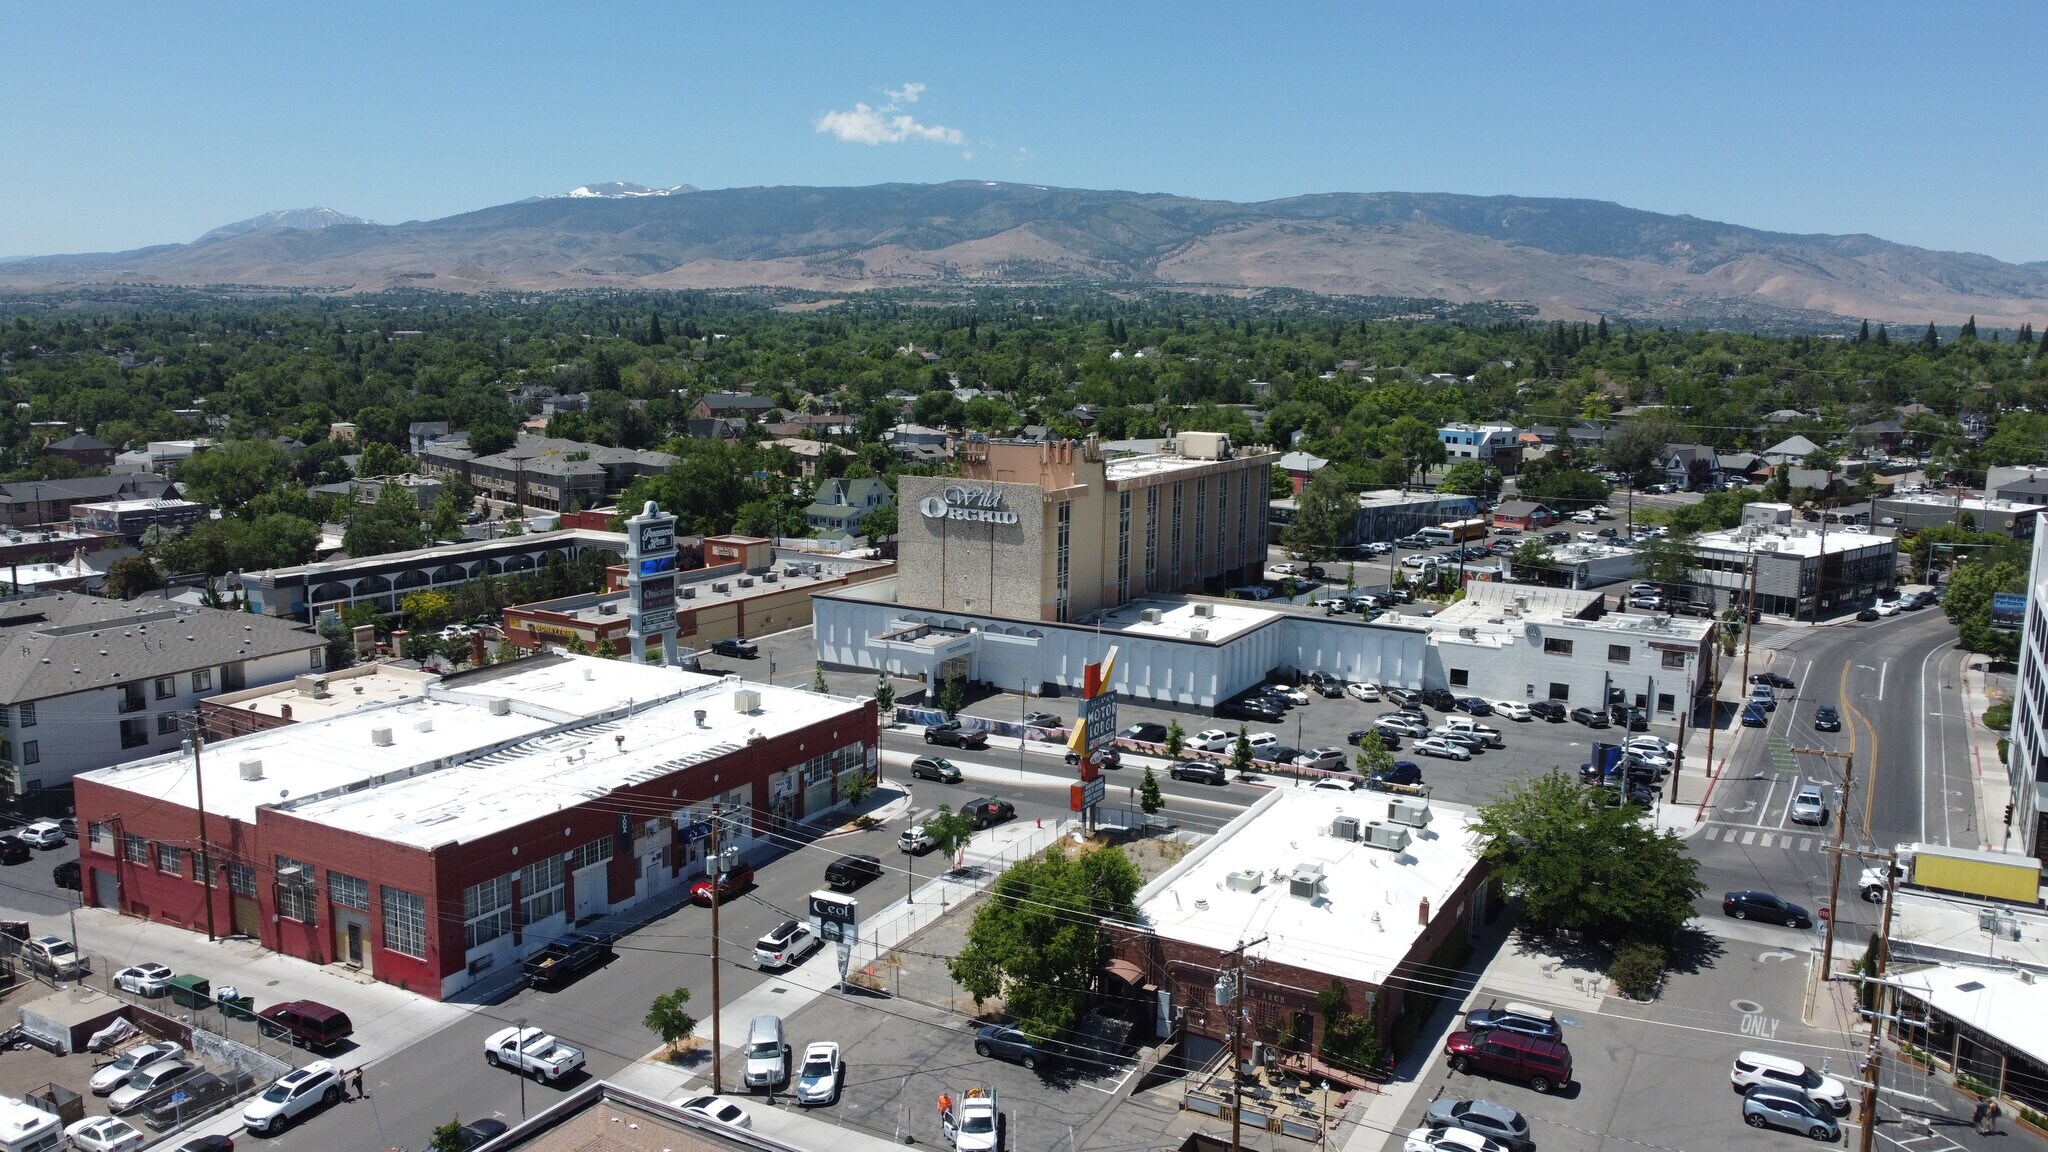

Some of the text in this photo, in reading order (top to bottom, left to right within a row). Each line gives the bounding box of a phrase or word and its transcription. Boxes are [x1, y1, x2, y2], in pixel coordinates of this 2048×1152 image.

[944, 486, 1002, 507] Wild
[1995, 599, 2025, 607] Partners
[1088, 701, 1117, 724] MOTOR
[813, 899, 850, 917] Ceol
[1261, 992, 1286, 1004] ARCH
[1739, 1013, 1780, 1038] ONLY
